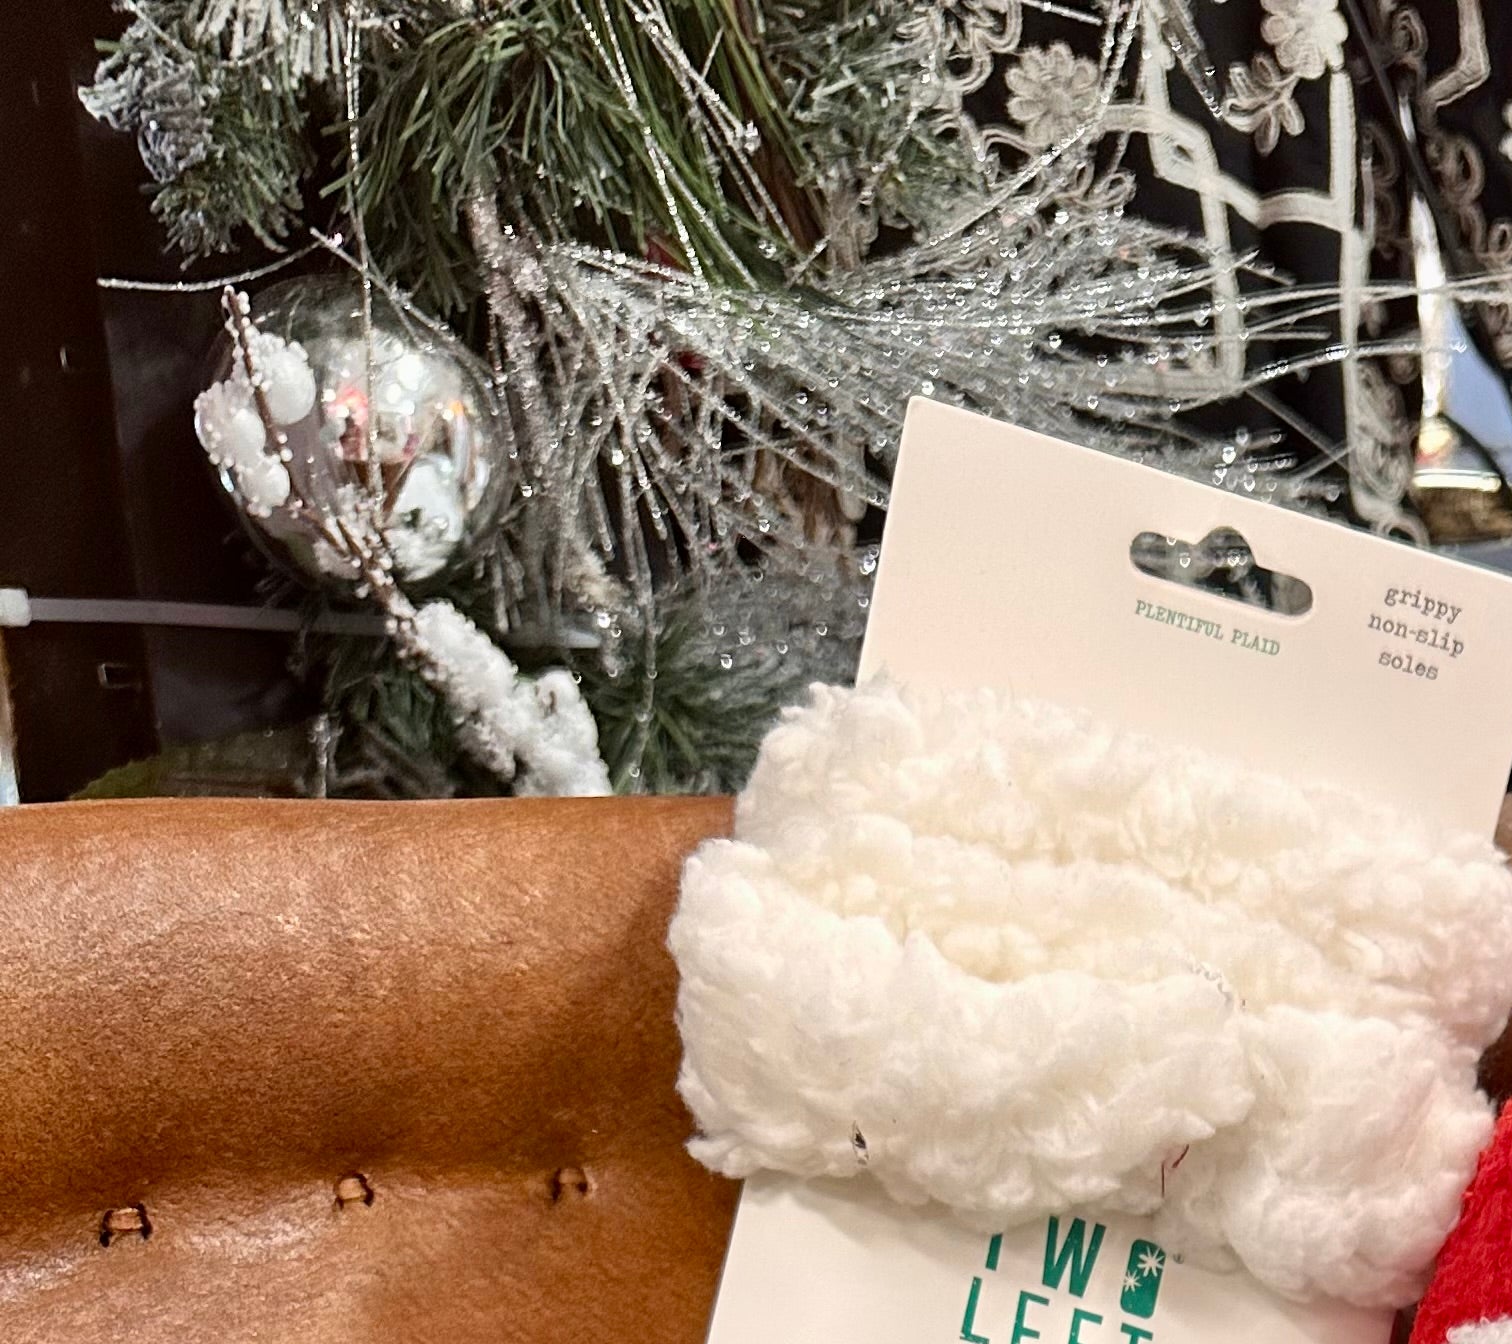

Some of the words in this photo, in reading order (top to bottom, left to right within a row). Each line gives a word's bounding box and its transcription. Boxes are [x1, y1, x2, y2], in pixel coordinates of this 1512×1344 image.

[1384, 585, 1463, 624] grippy
[1135, 600, 1223, 640] PLENTIFUL
[1230, 629, 1280, 657] PLAID
[1368, 612, 1465, 657] non-slip
[1378, 650, 1439, 681] soles
